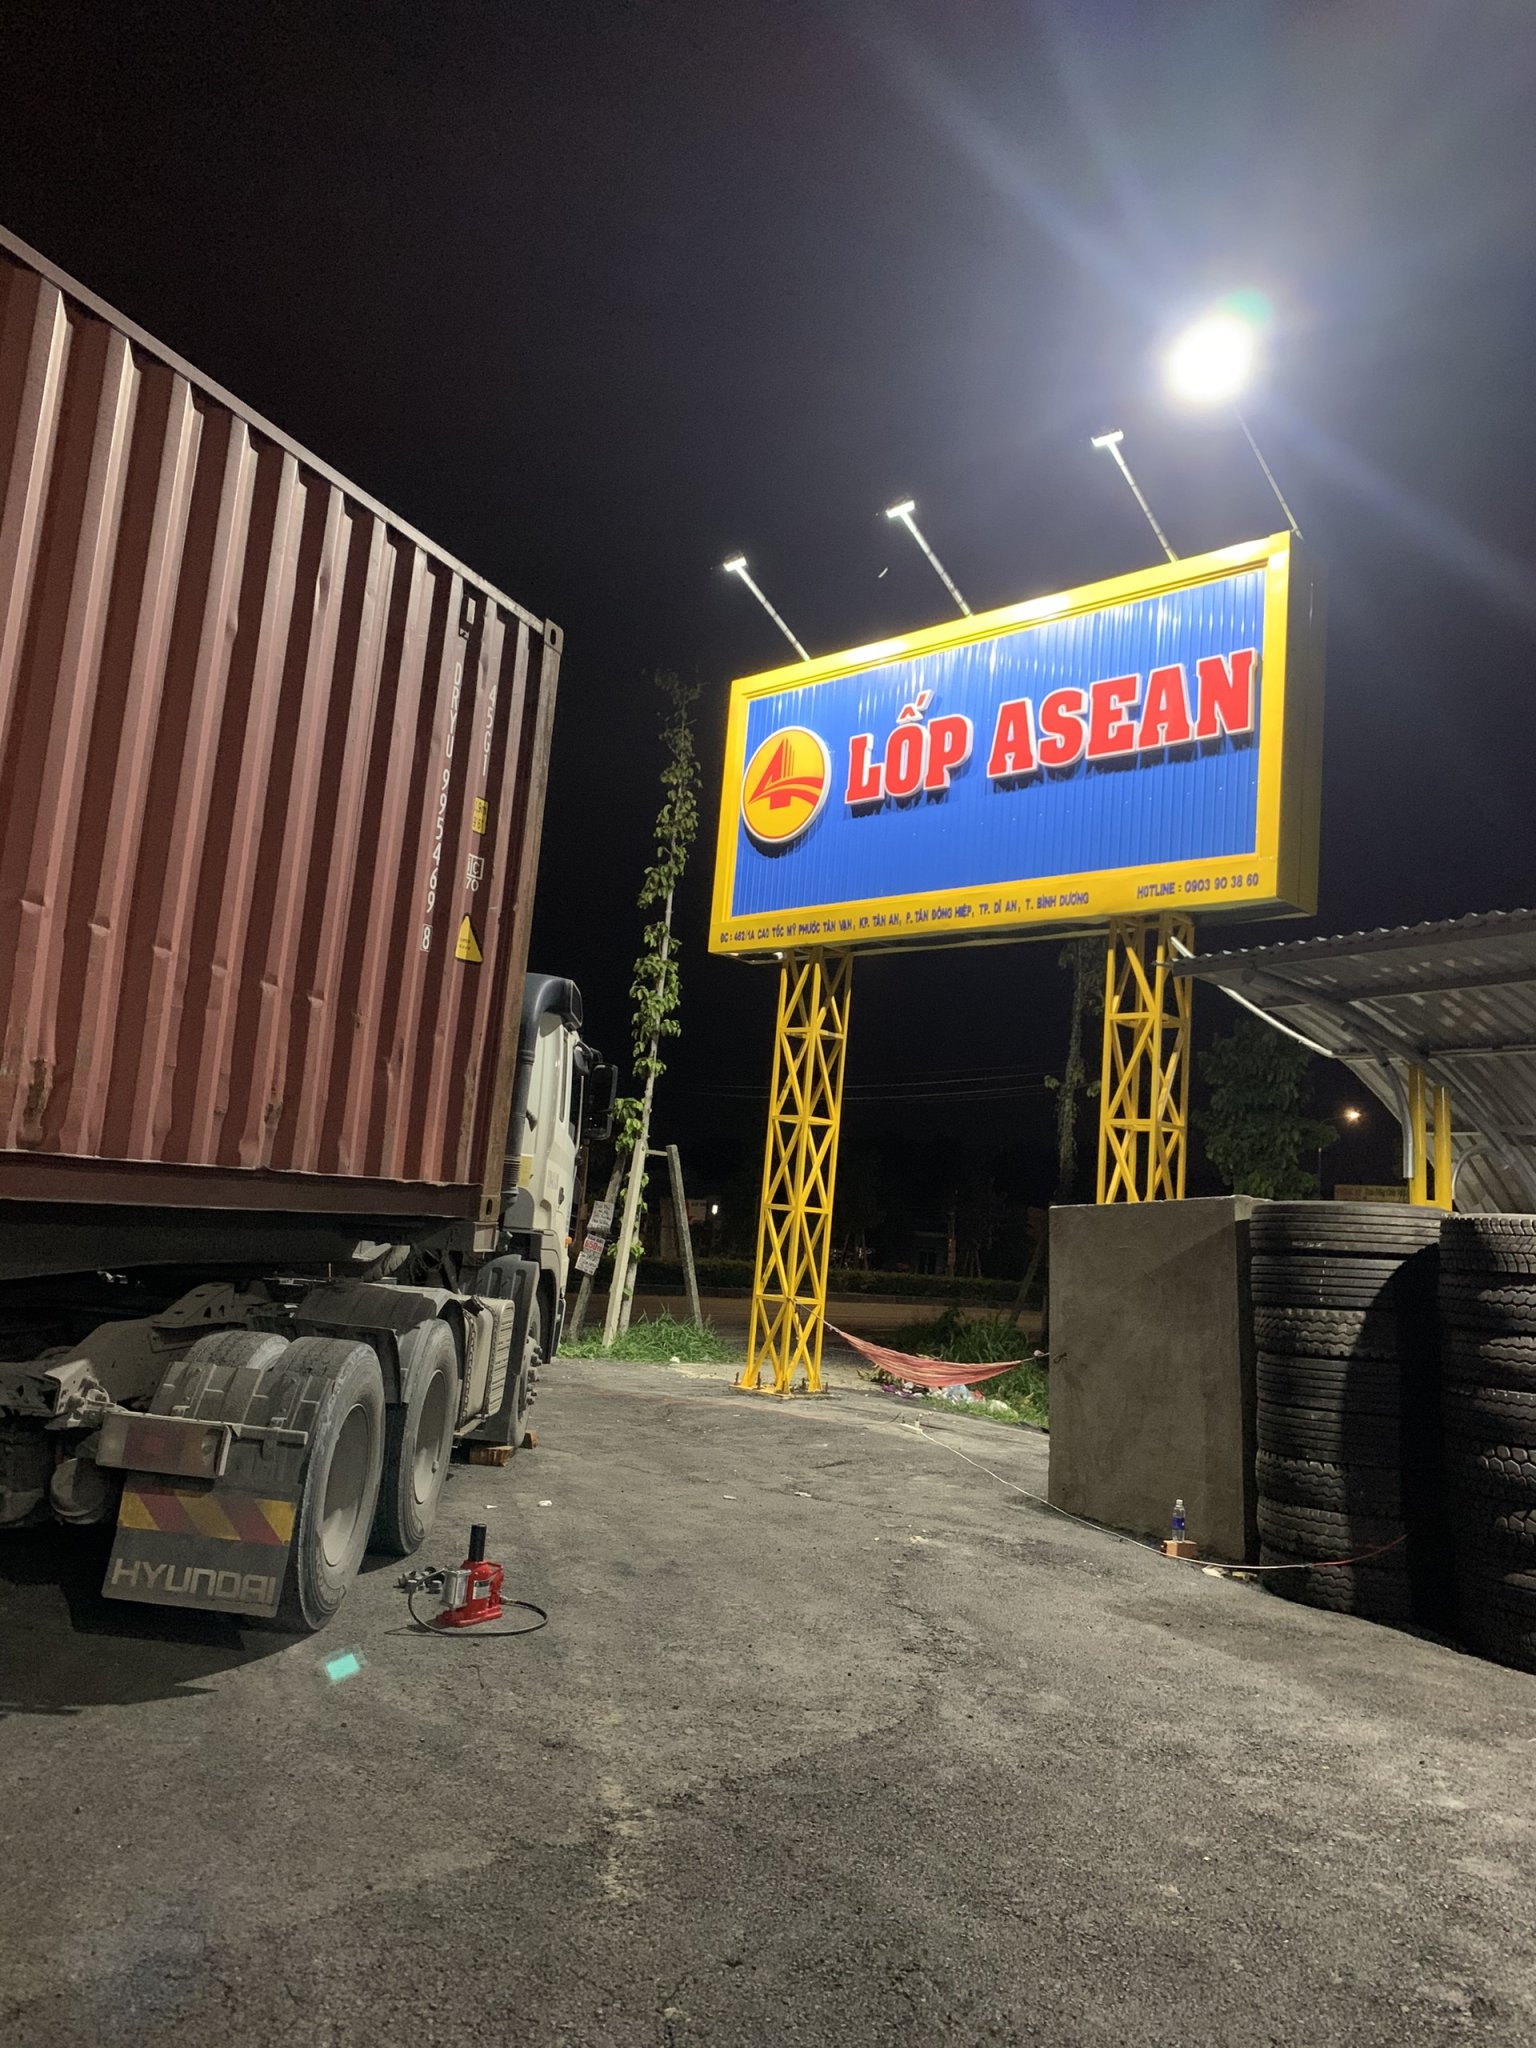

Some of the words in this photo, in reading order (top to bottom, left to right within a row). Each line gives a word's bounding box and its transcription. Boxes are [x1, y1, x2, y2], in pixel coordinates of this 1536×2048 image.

[445, 662, 462, 758] DRYU
[482, 685, 497, 777] 45G1
[845, 690, 974, 805] LỐP
[987, 647, 1258, 778] ASEAN
[426, 768, 450, 913] 995469
[465, 876, 479, 892] 70
[1137, 882, 1175, 899] HOTLINE
[1185, 878, 1210, 893] 0903
[1214, 876, 1227, 890] 90
[1231, 874, 1243, 888] 38
[1246, 872, 1259, 887] 60
[422, 926, 431, 950] 8
[757, 927, 769, 939] CAO
[979, 903, 990, 916] TP.
[1025, 898, 1034, 911] T.
[111, 1558, 277, 1604] HYUNDAI
